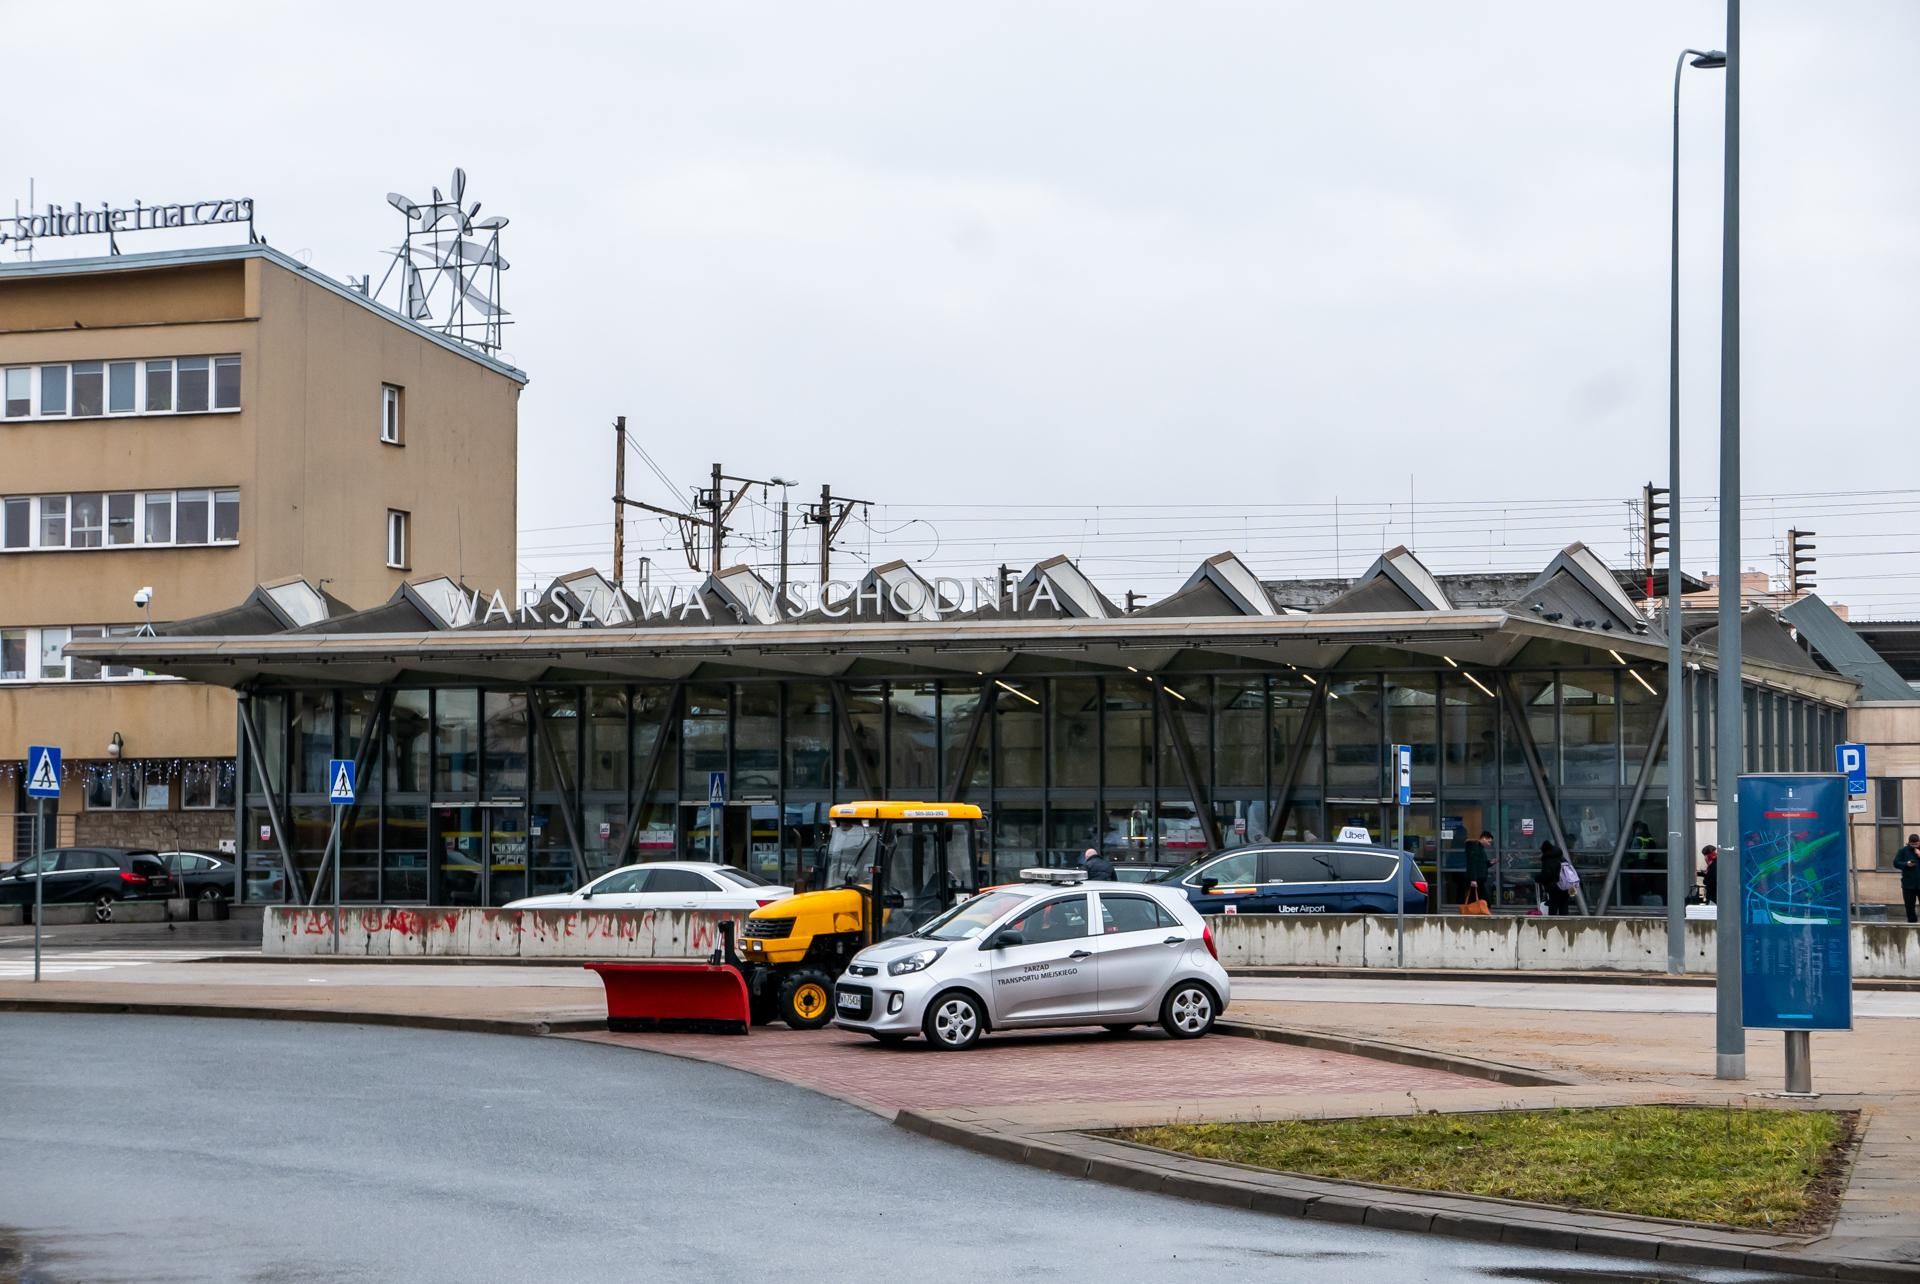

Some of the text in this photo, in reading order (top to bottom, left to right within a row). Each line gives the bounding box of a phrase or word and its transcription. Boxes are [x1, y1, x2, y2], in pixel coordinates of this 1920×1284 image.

[16, 201, 126, 240] solidnie
[133, 199, 141, 230] i
[150, 203, 185, 228] na
[193, 197, 252, 225] czas
[446, 575, 1062, 624] WARSZAWA WSCHODNIA
[1843, 749, 1860, 773] P
[1344, 830, 1366, 840] Uber
[1278, 904, 1326, 914] Uber Airport
[997, 968, 1078, 986] TRANSPORTU MIEJSKIEGO
